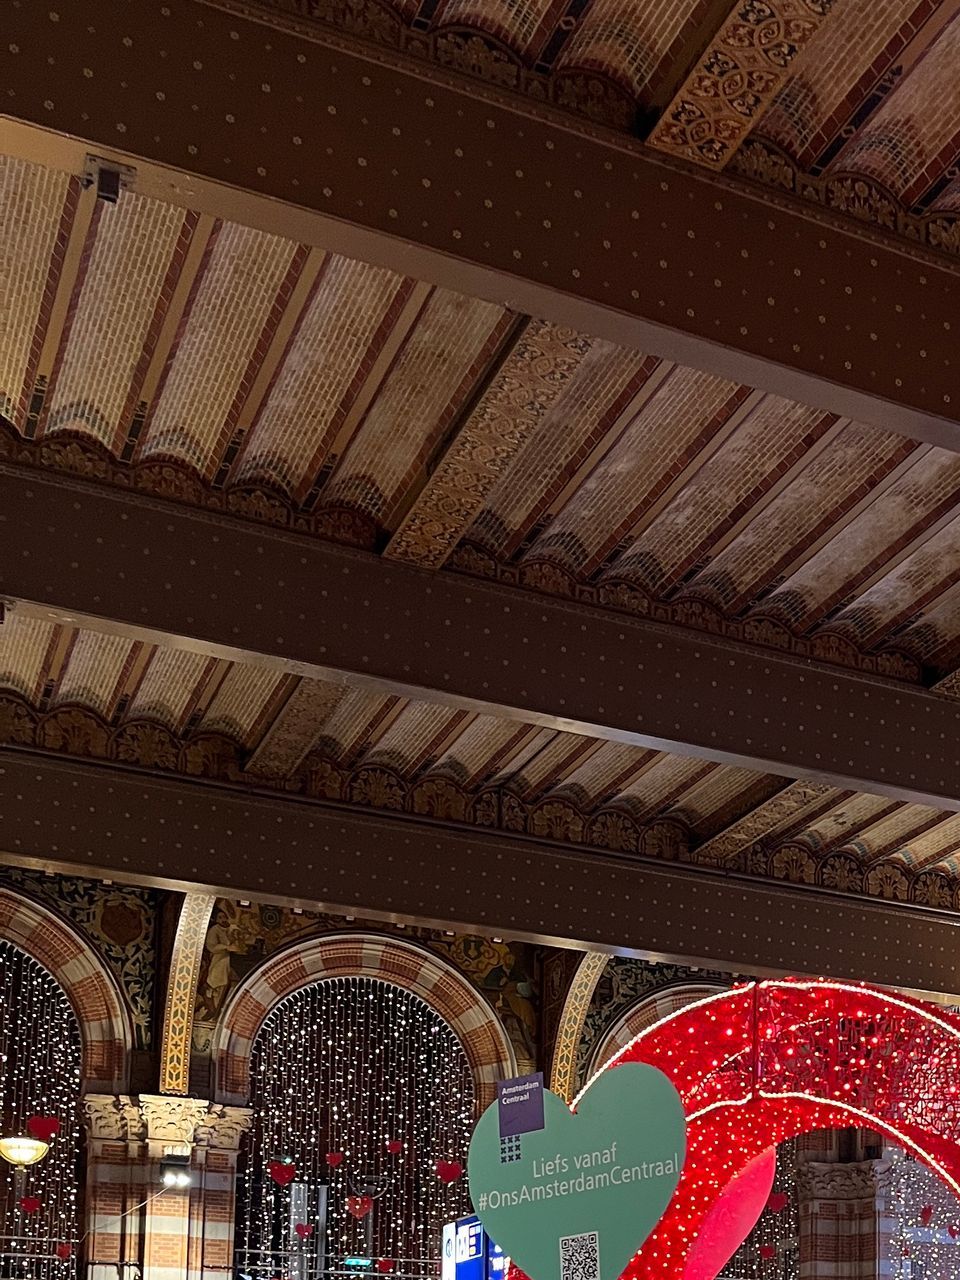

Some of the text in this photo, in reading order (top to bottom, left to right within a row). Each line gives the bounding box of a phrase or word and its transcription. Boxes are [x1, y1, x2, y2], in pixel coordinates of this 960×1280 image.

[502, 1082, 539, 1095] Amsterdam
[502, 1092, 530, 1105] Centraal
[533, 1142, 617, 1178] Liefs vanaf
[478, 1152, 679, 1211] #OnsAmsterdamCentraal
